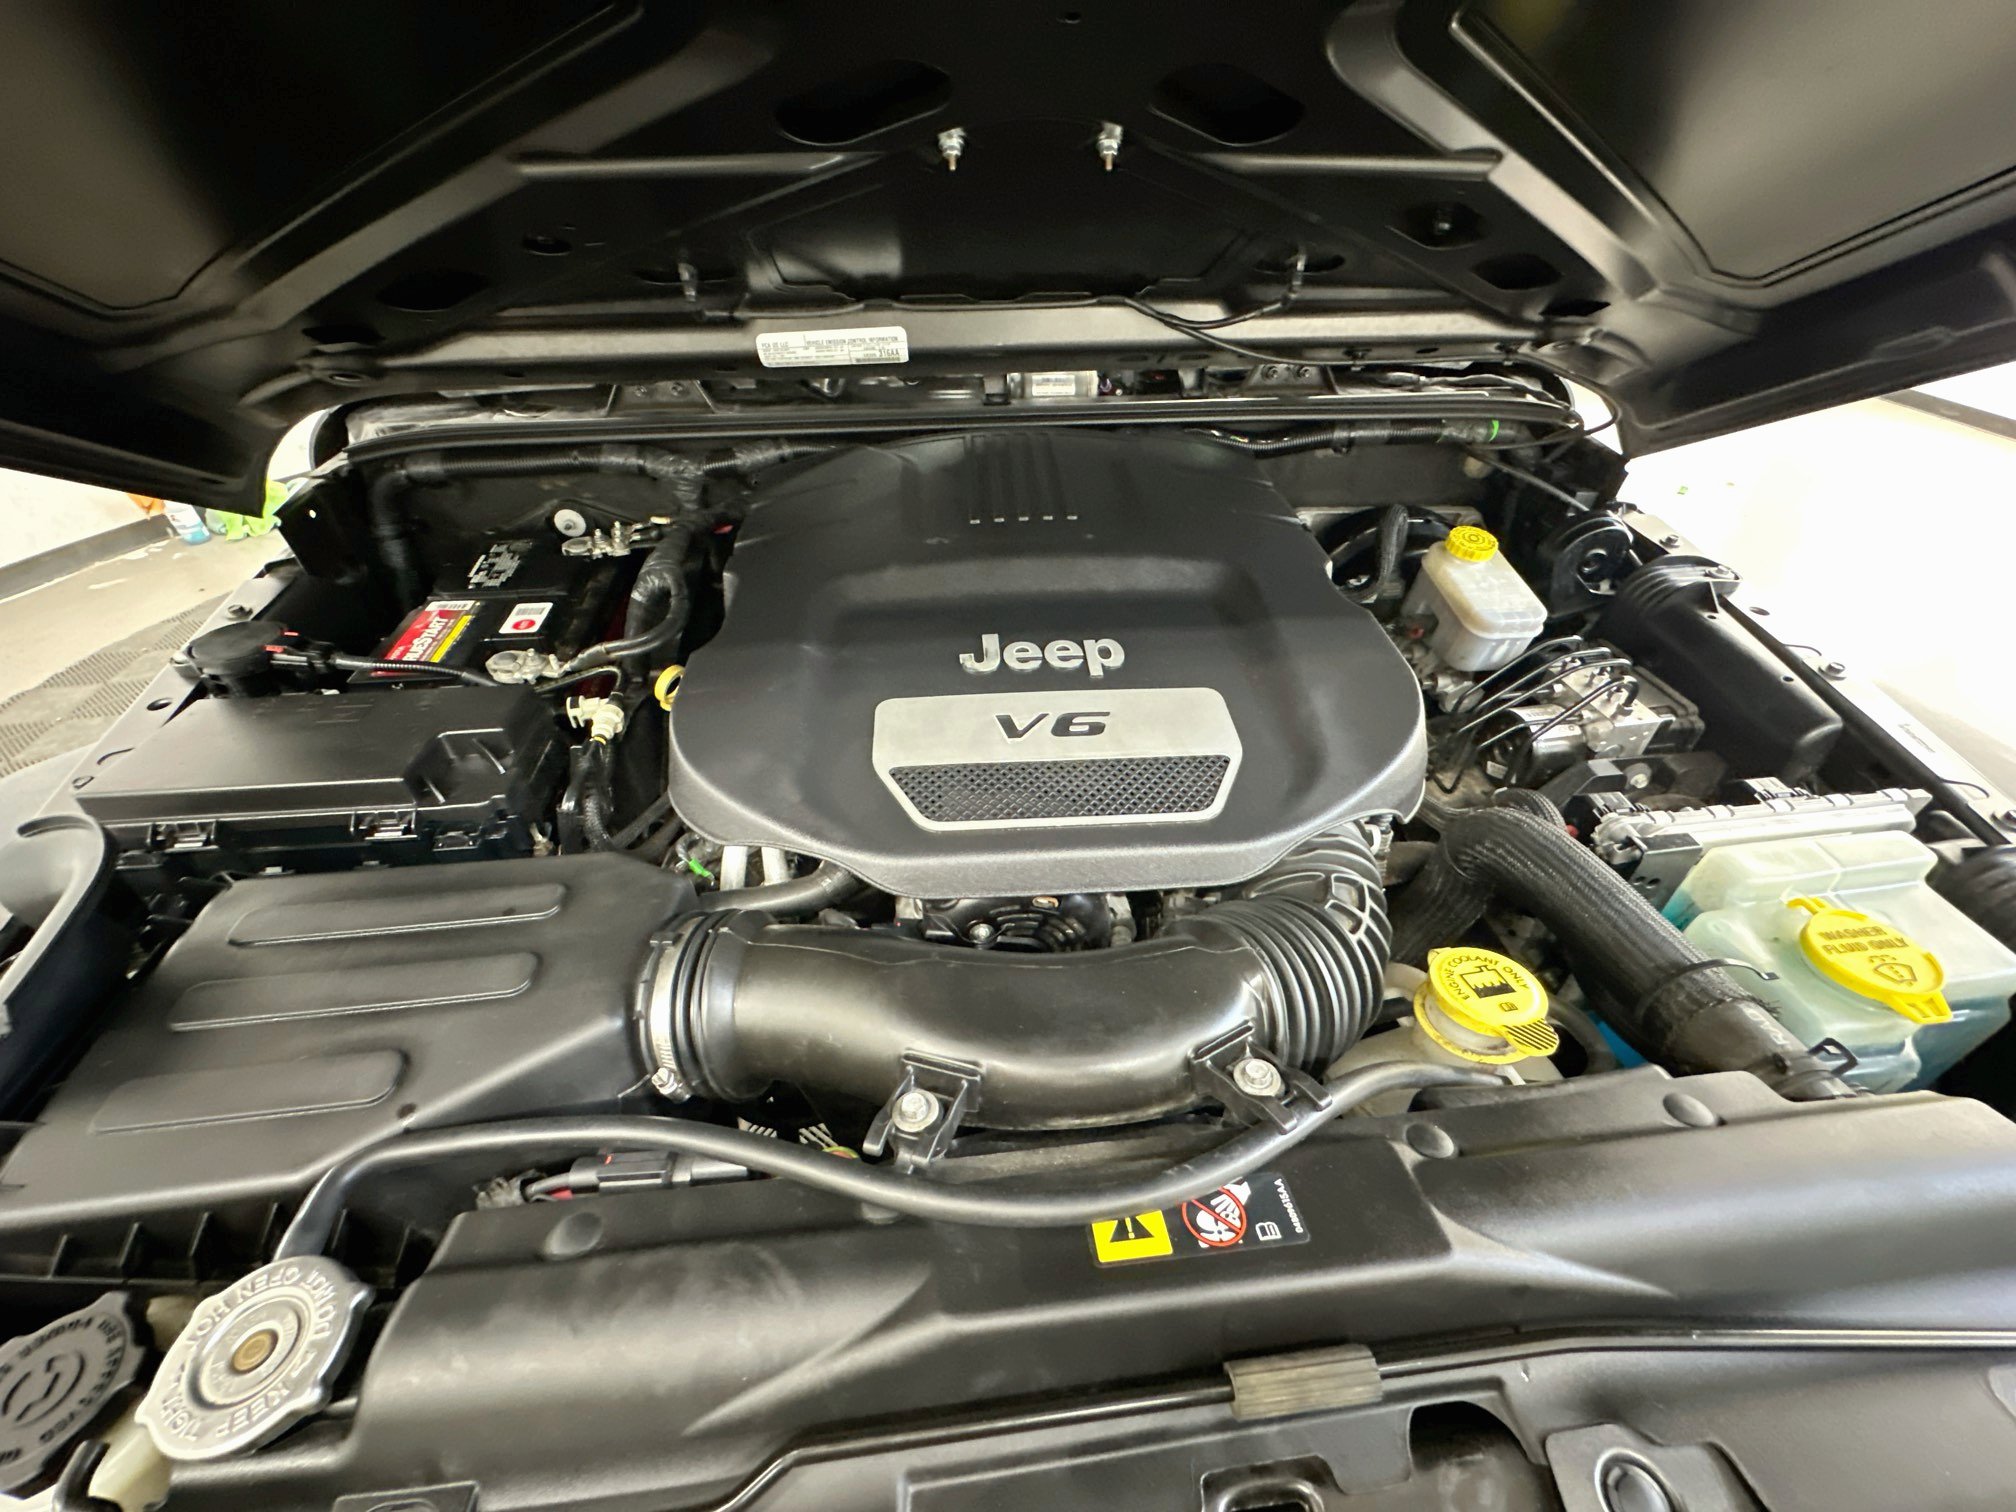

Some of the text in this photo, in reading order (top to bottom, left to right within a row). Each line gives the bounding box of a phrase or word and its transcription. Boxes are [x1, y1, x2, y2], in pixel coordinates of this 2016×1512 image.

[402, 617, 449, 661] RUESTART
[959, 633, 1126, 679] Jeep
[995, 711, 1112, 740] V6
[1818, 926, 1888, 941] WASHER
[1822, 937, 1910, 955] FLUID ONLY
[1444, 955, 1530, 1001] ENGINE COOLANT ONLY
[237, 1266, 301, 1304] OPEN
[185, 1302, 232, 1346] HOT
[160, 1382, 291, 1442] KEEP TIGHT
